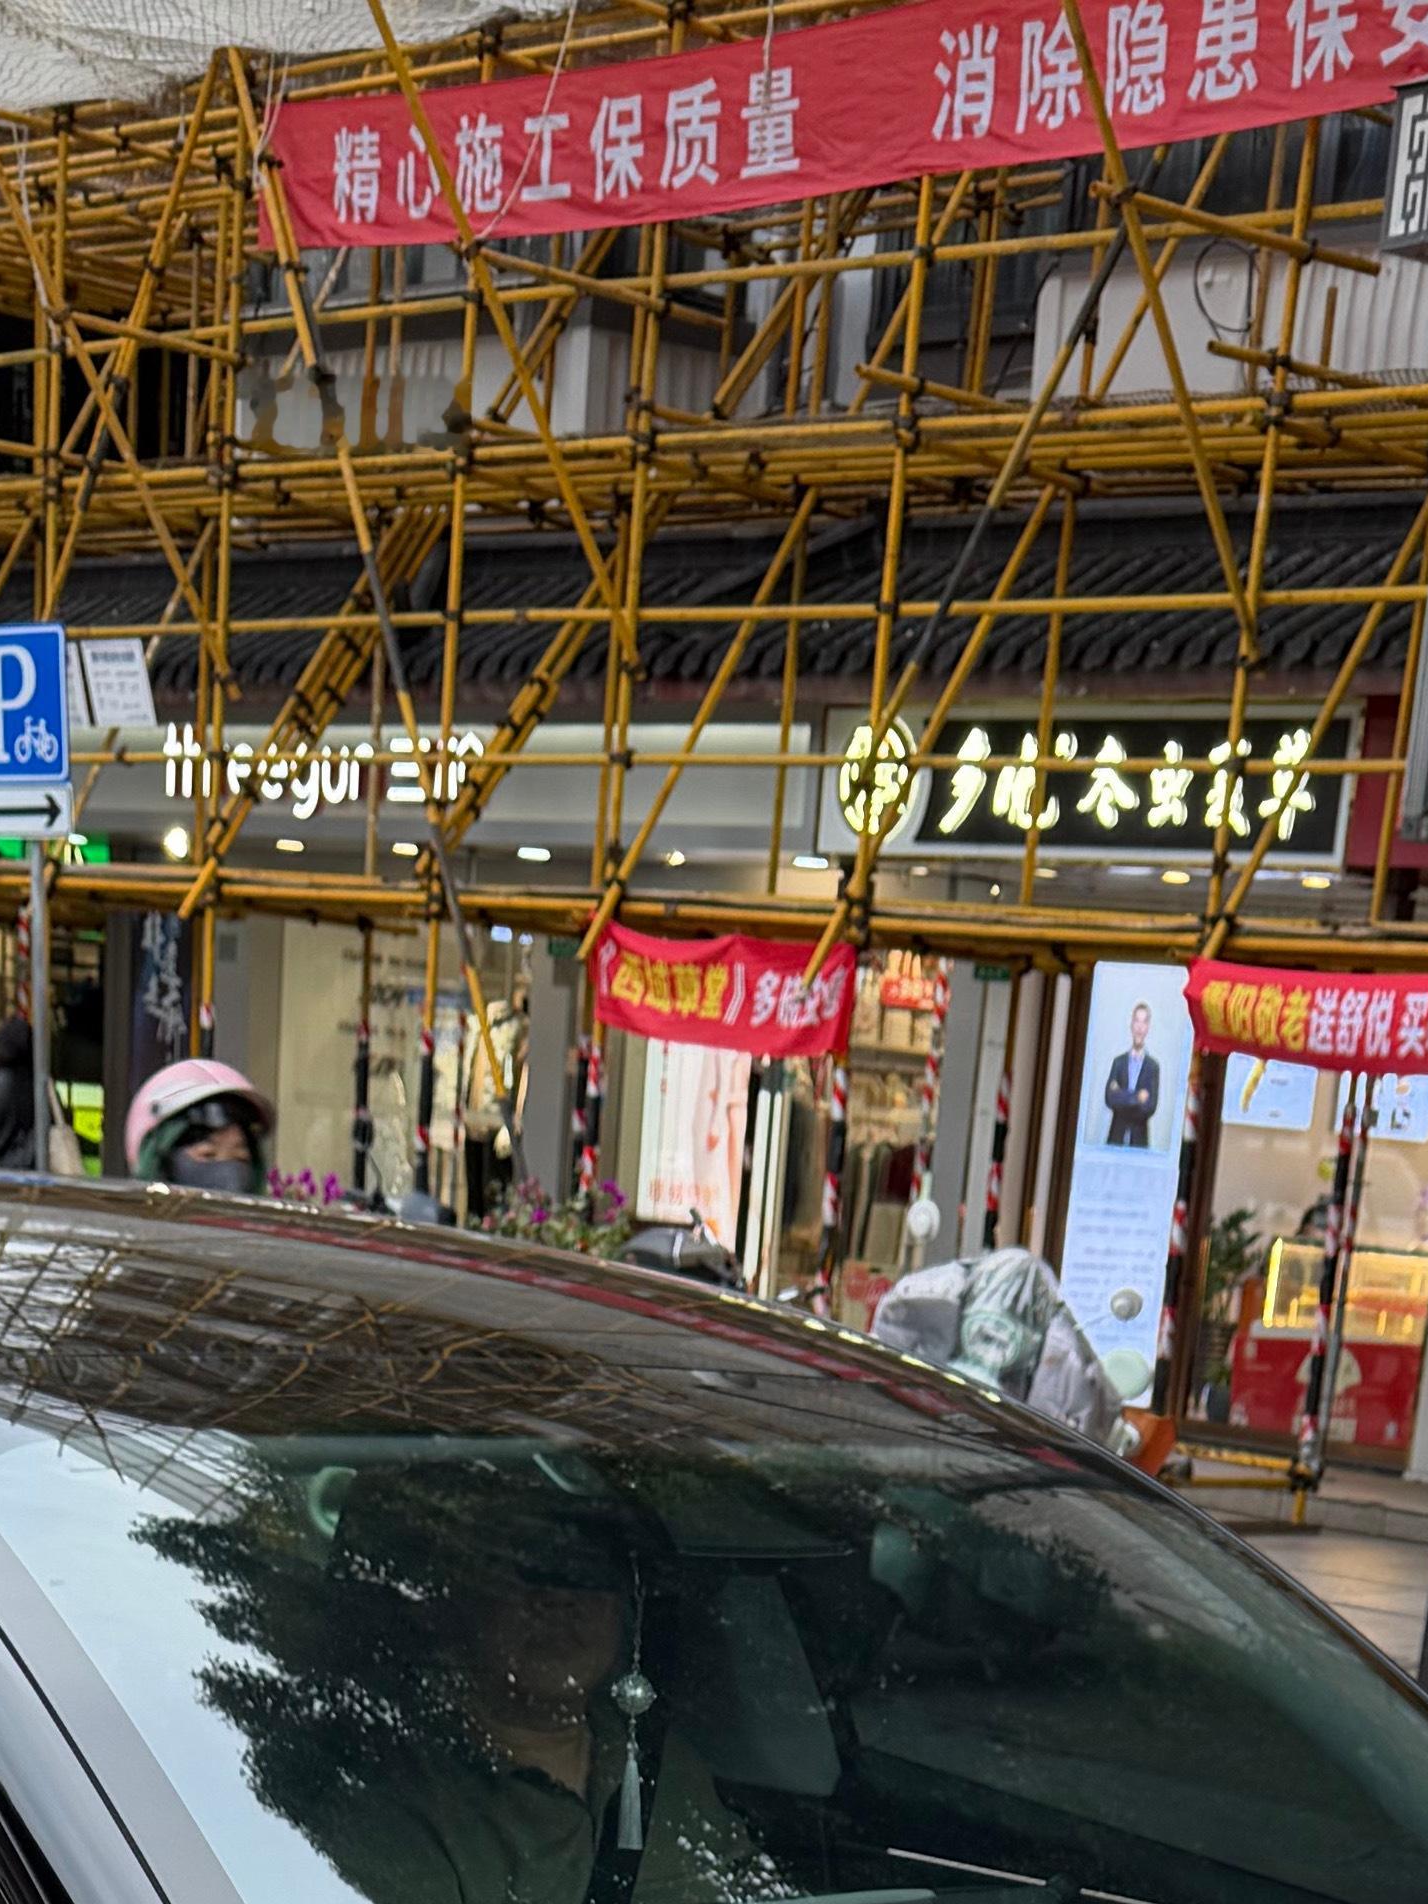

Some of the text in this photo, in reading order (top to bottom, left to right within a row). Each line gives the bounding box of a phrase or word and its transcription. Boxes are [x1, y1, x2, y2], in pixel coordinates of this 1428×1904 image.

[333, 66, 800, 224] 精心施工保质量
